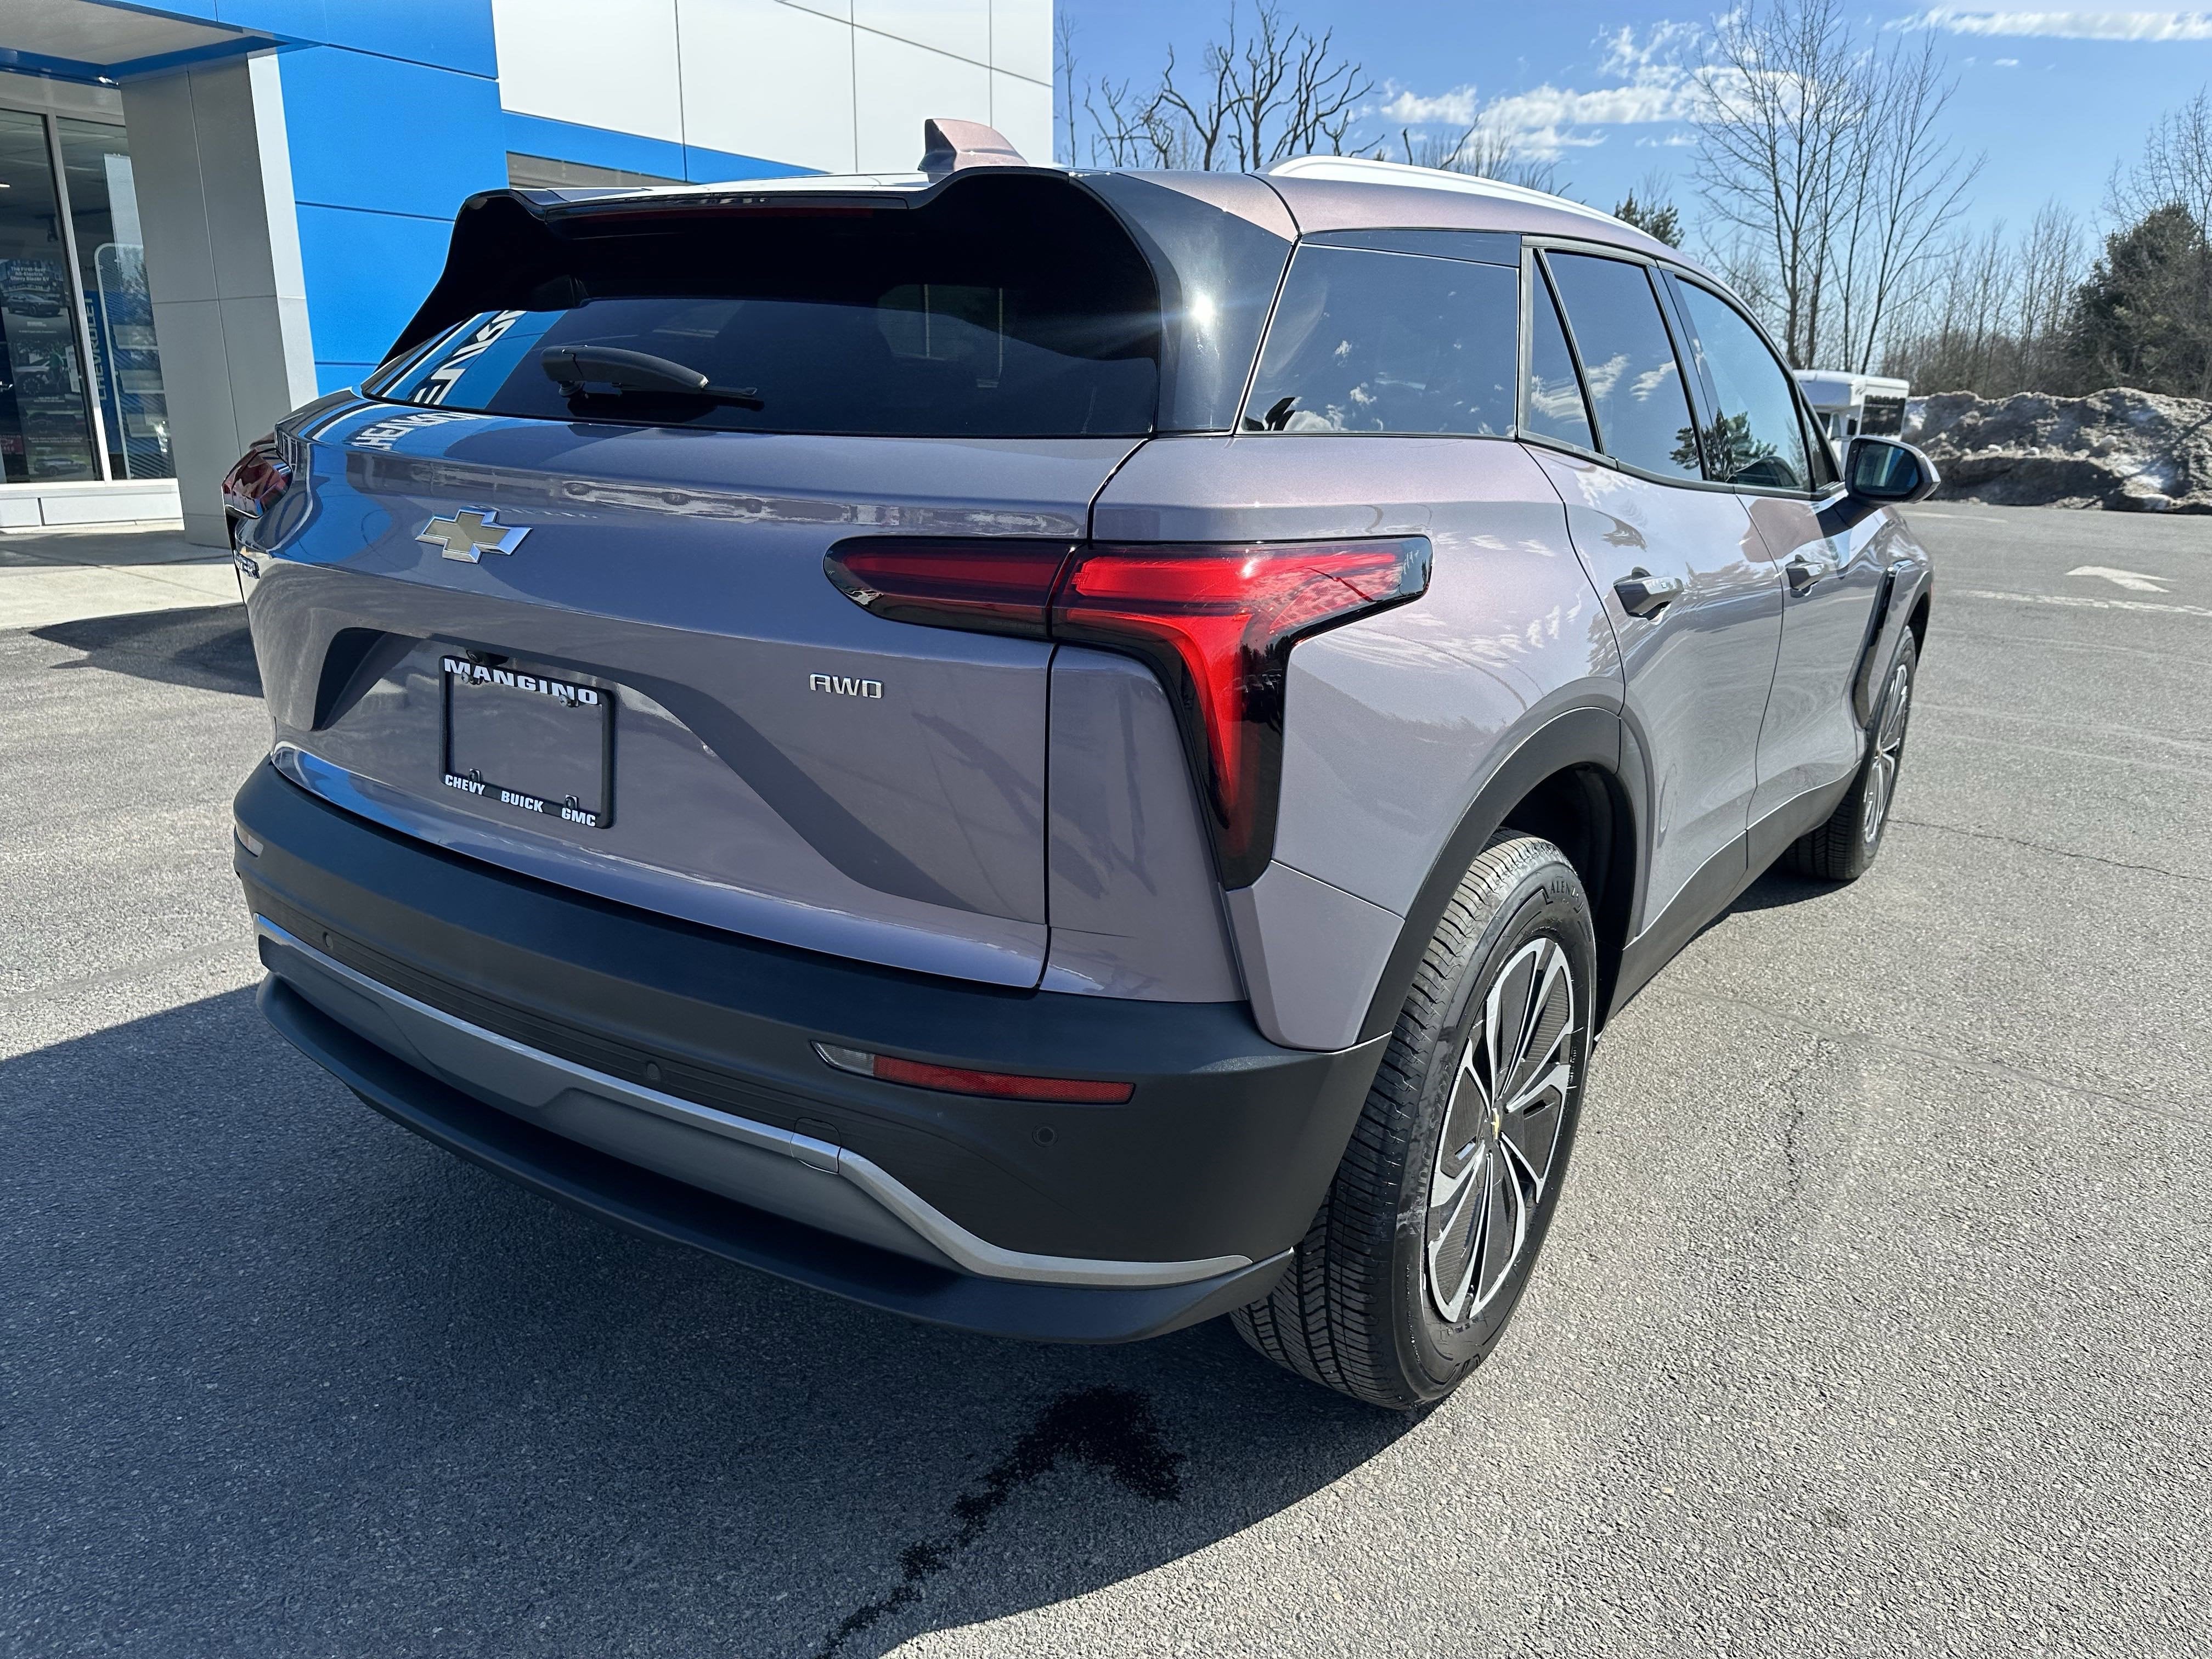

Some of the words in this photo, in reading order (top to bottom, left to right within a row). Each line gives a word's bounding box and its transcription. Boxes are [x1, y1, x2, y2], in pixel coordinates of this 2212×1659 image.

[444, 658, 598, 706] MANGINO
[809, 673, 884, 699] AWD
[444, 774, 486, 795] CHEVY
[500, 790, 544, 813] BUICK
[561, 808, 596, 827] GMC
[1550, 880, 1579, 902] ALENZA
